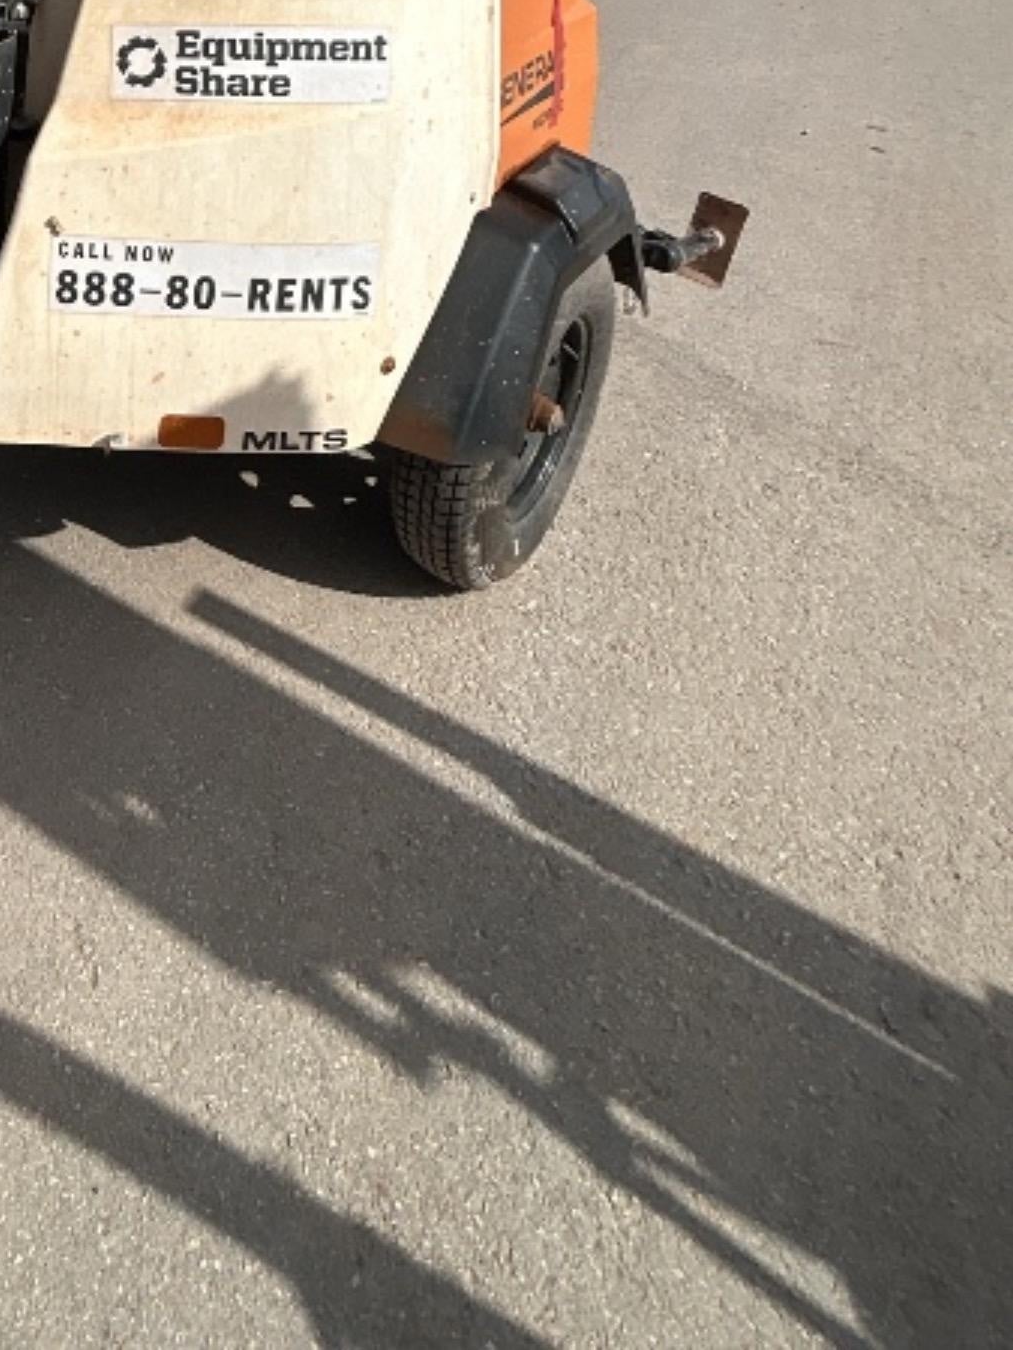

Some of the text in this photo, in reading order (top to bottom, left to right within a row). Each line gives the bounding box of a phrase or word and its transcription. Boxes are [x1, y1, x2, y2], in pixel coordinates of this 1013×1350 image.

[175, 29, 387, 67] Equipment
[175, 66, 291, 97] Share
[58, 242, 175, 264] CALL NOW
[55, 269, 373, 313] 888-80-RENTS
[241, 429, 349, 451] MLTS
